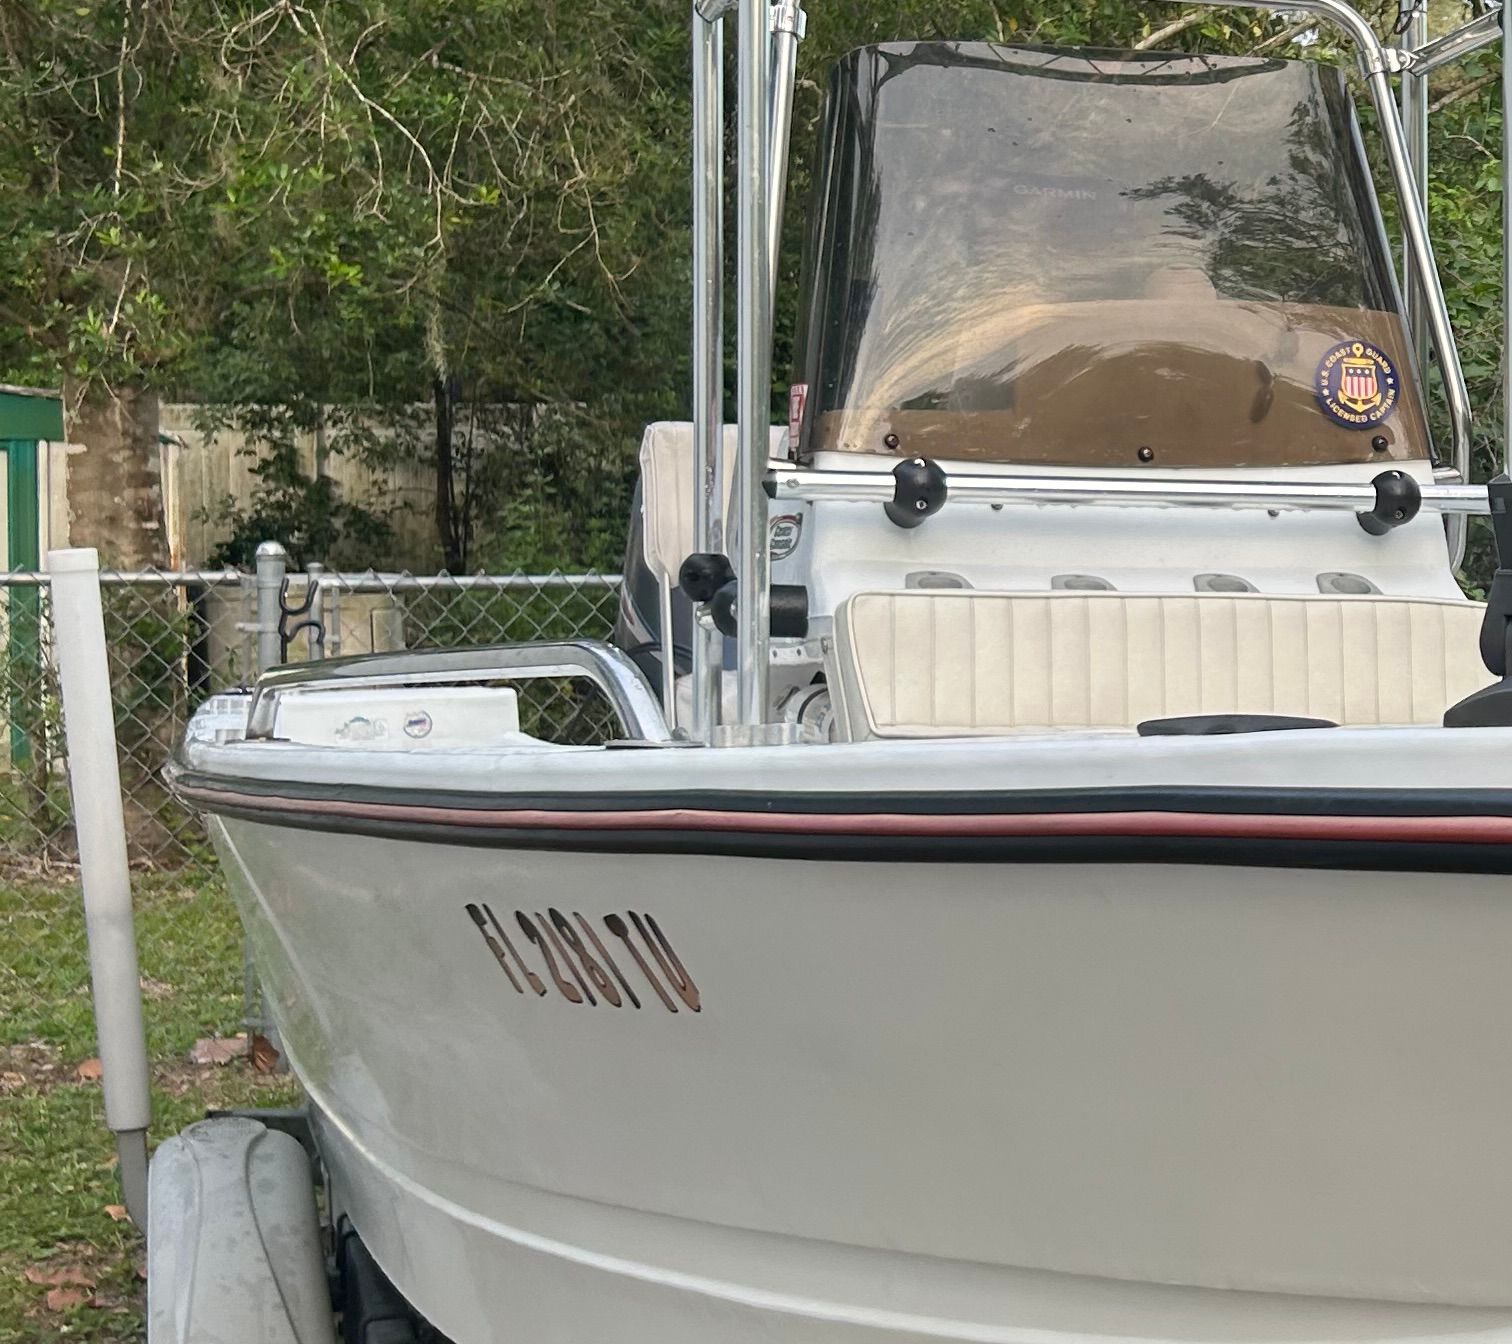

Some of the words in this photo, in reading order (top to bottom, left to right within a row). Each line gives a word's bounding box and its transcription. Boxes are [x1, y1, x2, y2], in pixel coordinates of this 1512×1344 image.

[1013, 184, 1097, 201] GARMIN
[1325, 346, 1351, 368] COAST
[1365, 348, 1391, 374] GUARD
[1325, 397, 1368, 423] LICENSED
[1369, 388, 1396, 421] CAPTAIN
[465, 903, 547, 997] FL
[514, 906, 641, 1009] 2181
